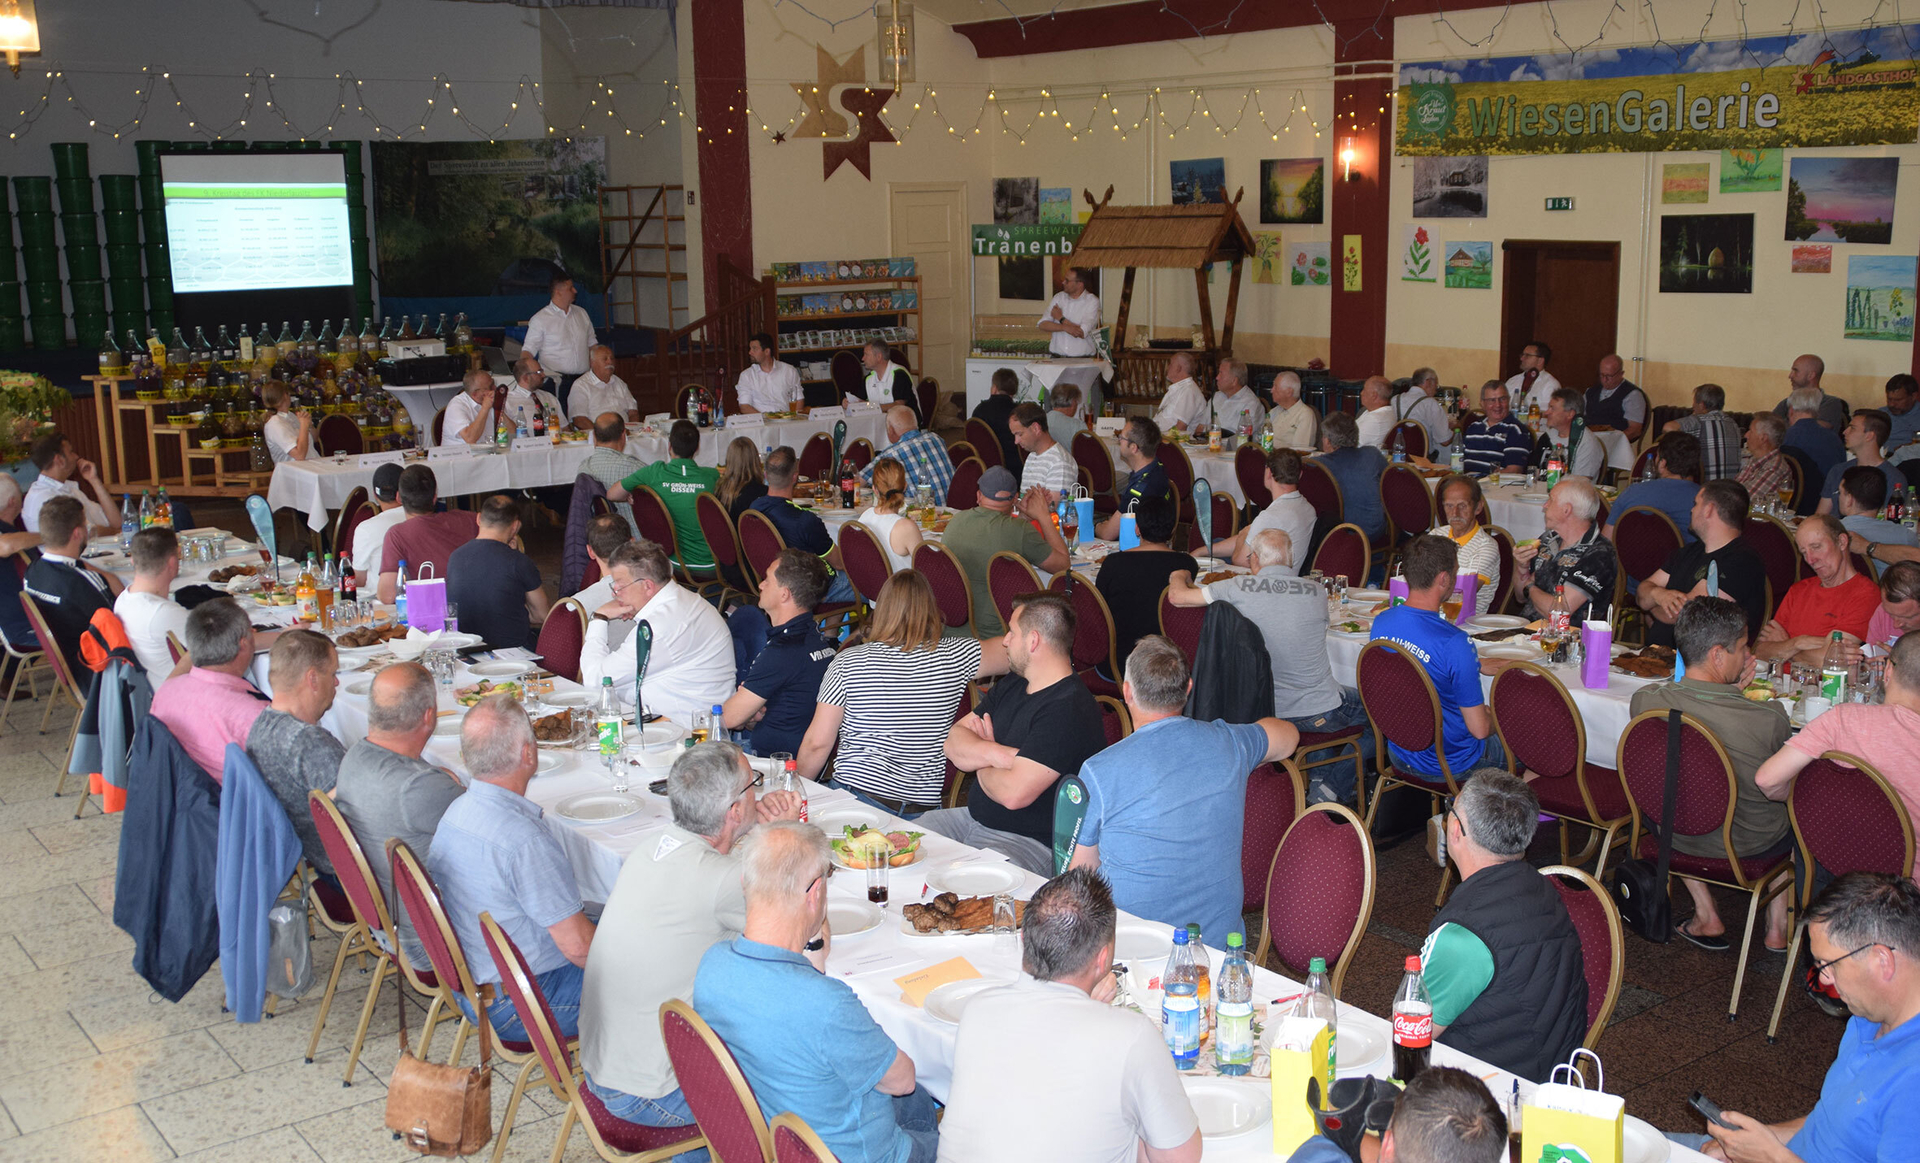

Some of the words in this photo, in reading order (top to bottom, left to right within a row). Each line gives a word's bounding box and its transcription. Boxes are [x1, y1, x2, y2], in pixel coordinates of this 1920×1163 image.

[1817, 69, 1917, 86] LANDGASTHOF
[1467, 81, 1780, 137] WiesenGalerie
[1067, 837, 1077, 857] ECHTE
